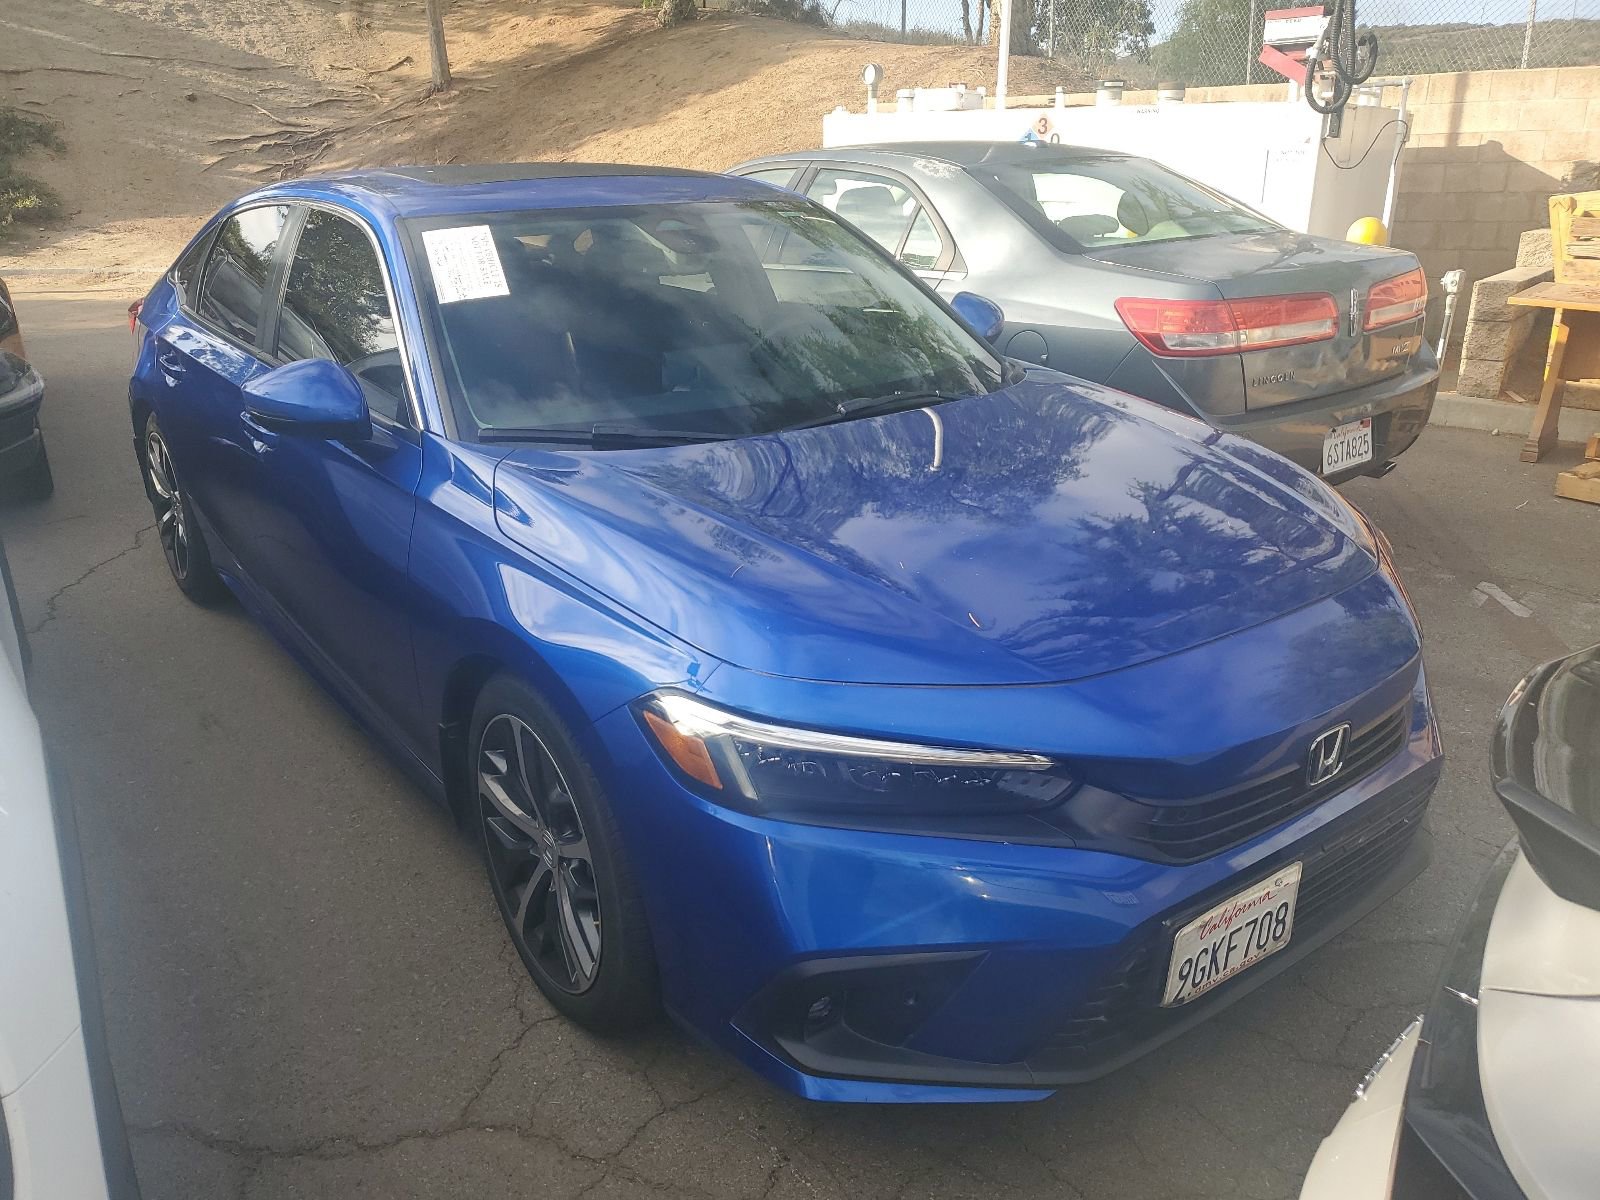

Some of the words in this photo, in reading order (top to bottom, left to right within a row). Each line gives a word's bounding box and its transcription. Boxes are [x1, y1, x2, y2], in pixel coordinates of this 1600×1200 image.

[1038, 117, 1048, 134] 3
[1252, 370, 1296, 387] LINCOLN
[1326, 433, 1369, 466] 6STA825
[1200, 890, 1278, 940] California
[1173, 901, 1289, 1001] 9GKF708
